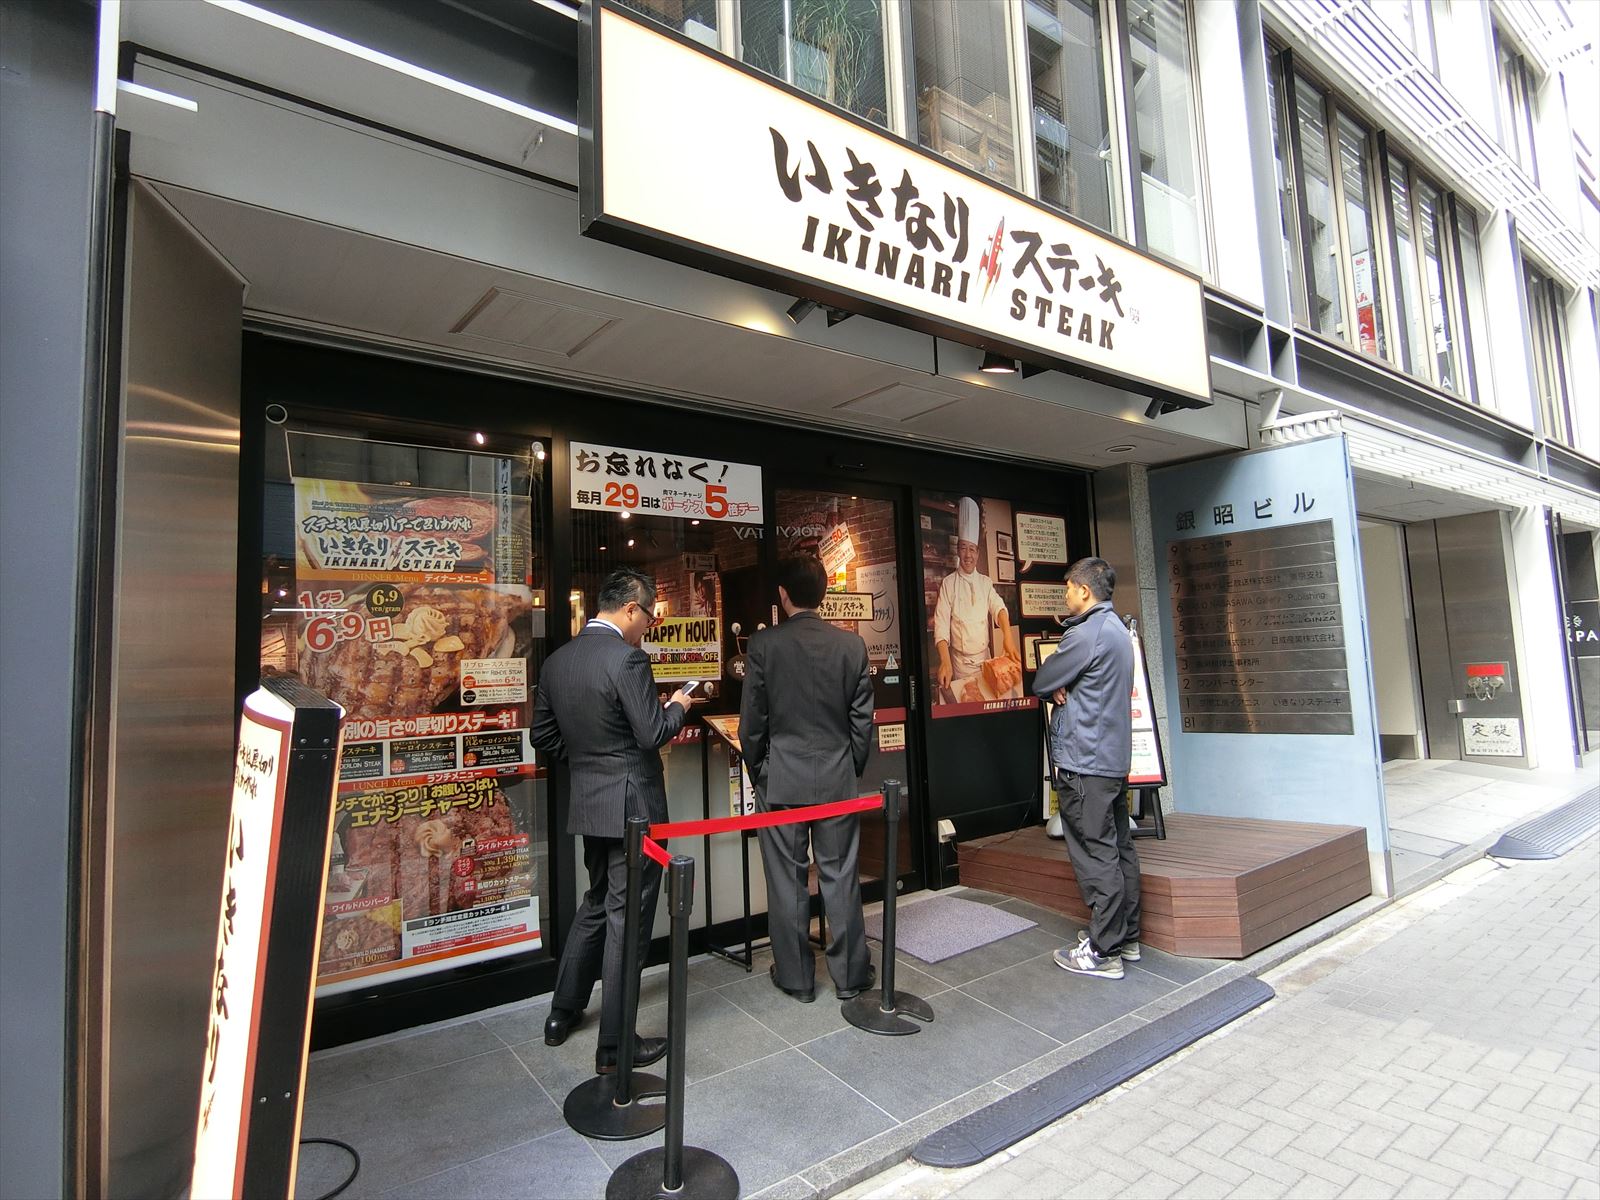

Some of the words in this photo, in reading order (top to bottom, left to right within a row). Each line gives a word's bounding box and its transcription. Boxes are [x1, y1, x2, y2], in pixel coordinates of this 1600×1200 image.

[769, 126, 970, 264] いきなり
[1009, 229, 1125, 317] ステーキ
[802, 215, 971, 303] IKINARI
[1010, 289, 1115, 351] STEAK
[1176, 492, 1315, 531] 銀昭ビル
[318, 535, 389, 557] いきなり
[404, 540, 460, 557] ステーキ
[1171, 545, 1178, 555] 9
[324, 556, 386, 568] IKINARI
[402, 559, 453, 570] STEAK
[1173, 564, 1180, 575] 8
[352, 573, 392, 581] DINNER
[394, 574, 419, 583] Menu
[425, 574, 488, 583] ディナーメニュー
[1175, 583, 1181, 594] 7
[372, 589, 399, 606] 6.9
[1177, 603, 1184, 613] 6
[306, 613, 391, 651] 6.9円
[644, 623, 683, 643] HAPPY
[685, 619, 717, 643] HOUR
[1179, 621, 1185, 632] 5
[1180, 640, 1186, 650] 4
[660, 653, 686, 664] DRINK
[703, 652, 719, 661] OFF
[464, 661, 524, 669] リブロースステーキ
[1183, 678, 1190, 689] 2
[1273, 697, 1342, 707] いきなりステーキ
[1472, 722, 1511, 737] 定礎
[393, 741, 455, 752] サーロインステーキ
[432, 753, 448, 761] STEAK
[364, 760, 382, 768] STEAK
[427, 771, 483, 783] ランチメニュー
[353, 780, 388, 791] LUNCH
[392, 778, 417, 787] Menu
[478, 837, 528, 851] ワイルドステーキ
[332, 896, 390, 913] ワイルドハンバーグ
